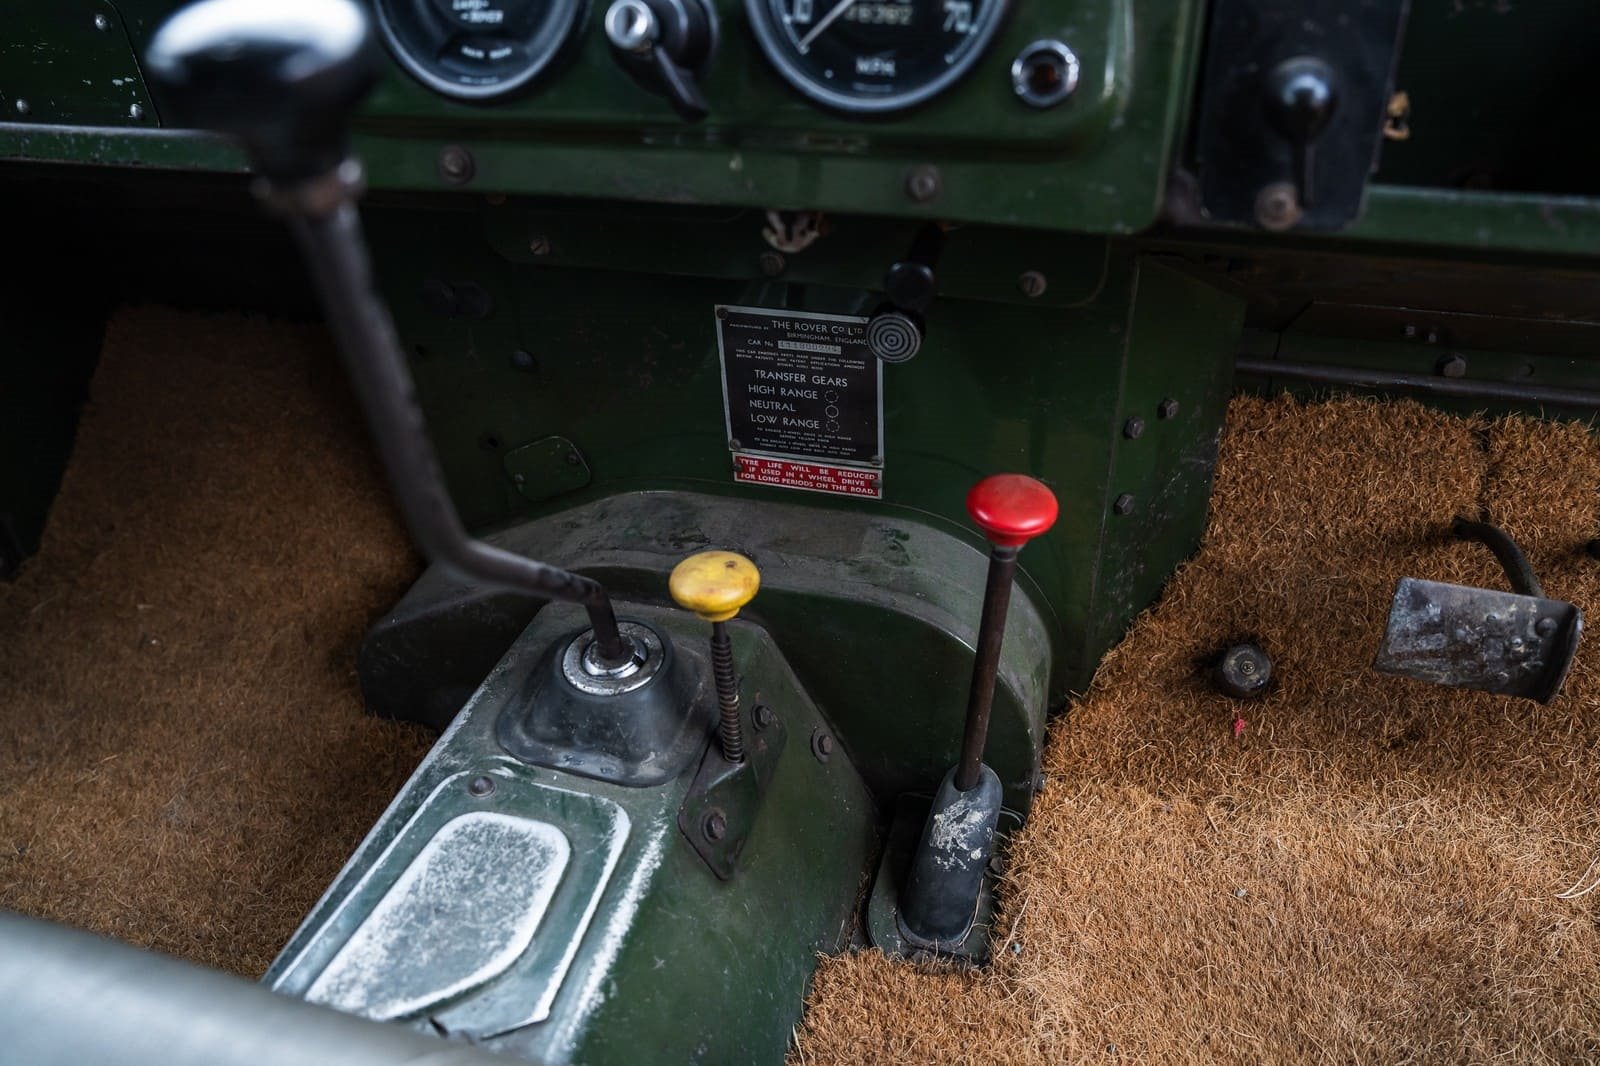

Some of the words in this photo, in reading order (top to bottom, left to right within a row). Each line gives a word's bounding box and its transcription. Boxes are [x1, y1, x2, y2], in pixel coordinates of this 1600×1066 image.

[943, 2, 972, 33] 70
[771, 320, 790, 330] THE
[794, 322, 828, 334] ROVER
[747, 338, 761, 346] CAR
[754, 369, 807, 383] TRANSFER
[812, 375, 848, 387] GEARS
[748, 384, 775, 395] HIGH
[780, 386, 819, 399] RANGE
[749, 399, 797, 412] NEUTRAL
[750, 413, 777, 424] LOW
[782, 418, 820, 429] RANGE
[740, 458, 759, 467] TYRE
[790, 464, 811, 473] WILL
[838, 470, 876, 480] REDUCED
[761, 468, 781, 476] USED
[808, 474, 836, 483] WHEEL
[842, 478, 865, 486] DRIVE
[758, 475, 780, 483] LONG
[782, 478, 813, 487] PERIODS
[831, 484, 847, 492] THE
[850, 487, 876, 495] ROAD.
